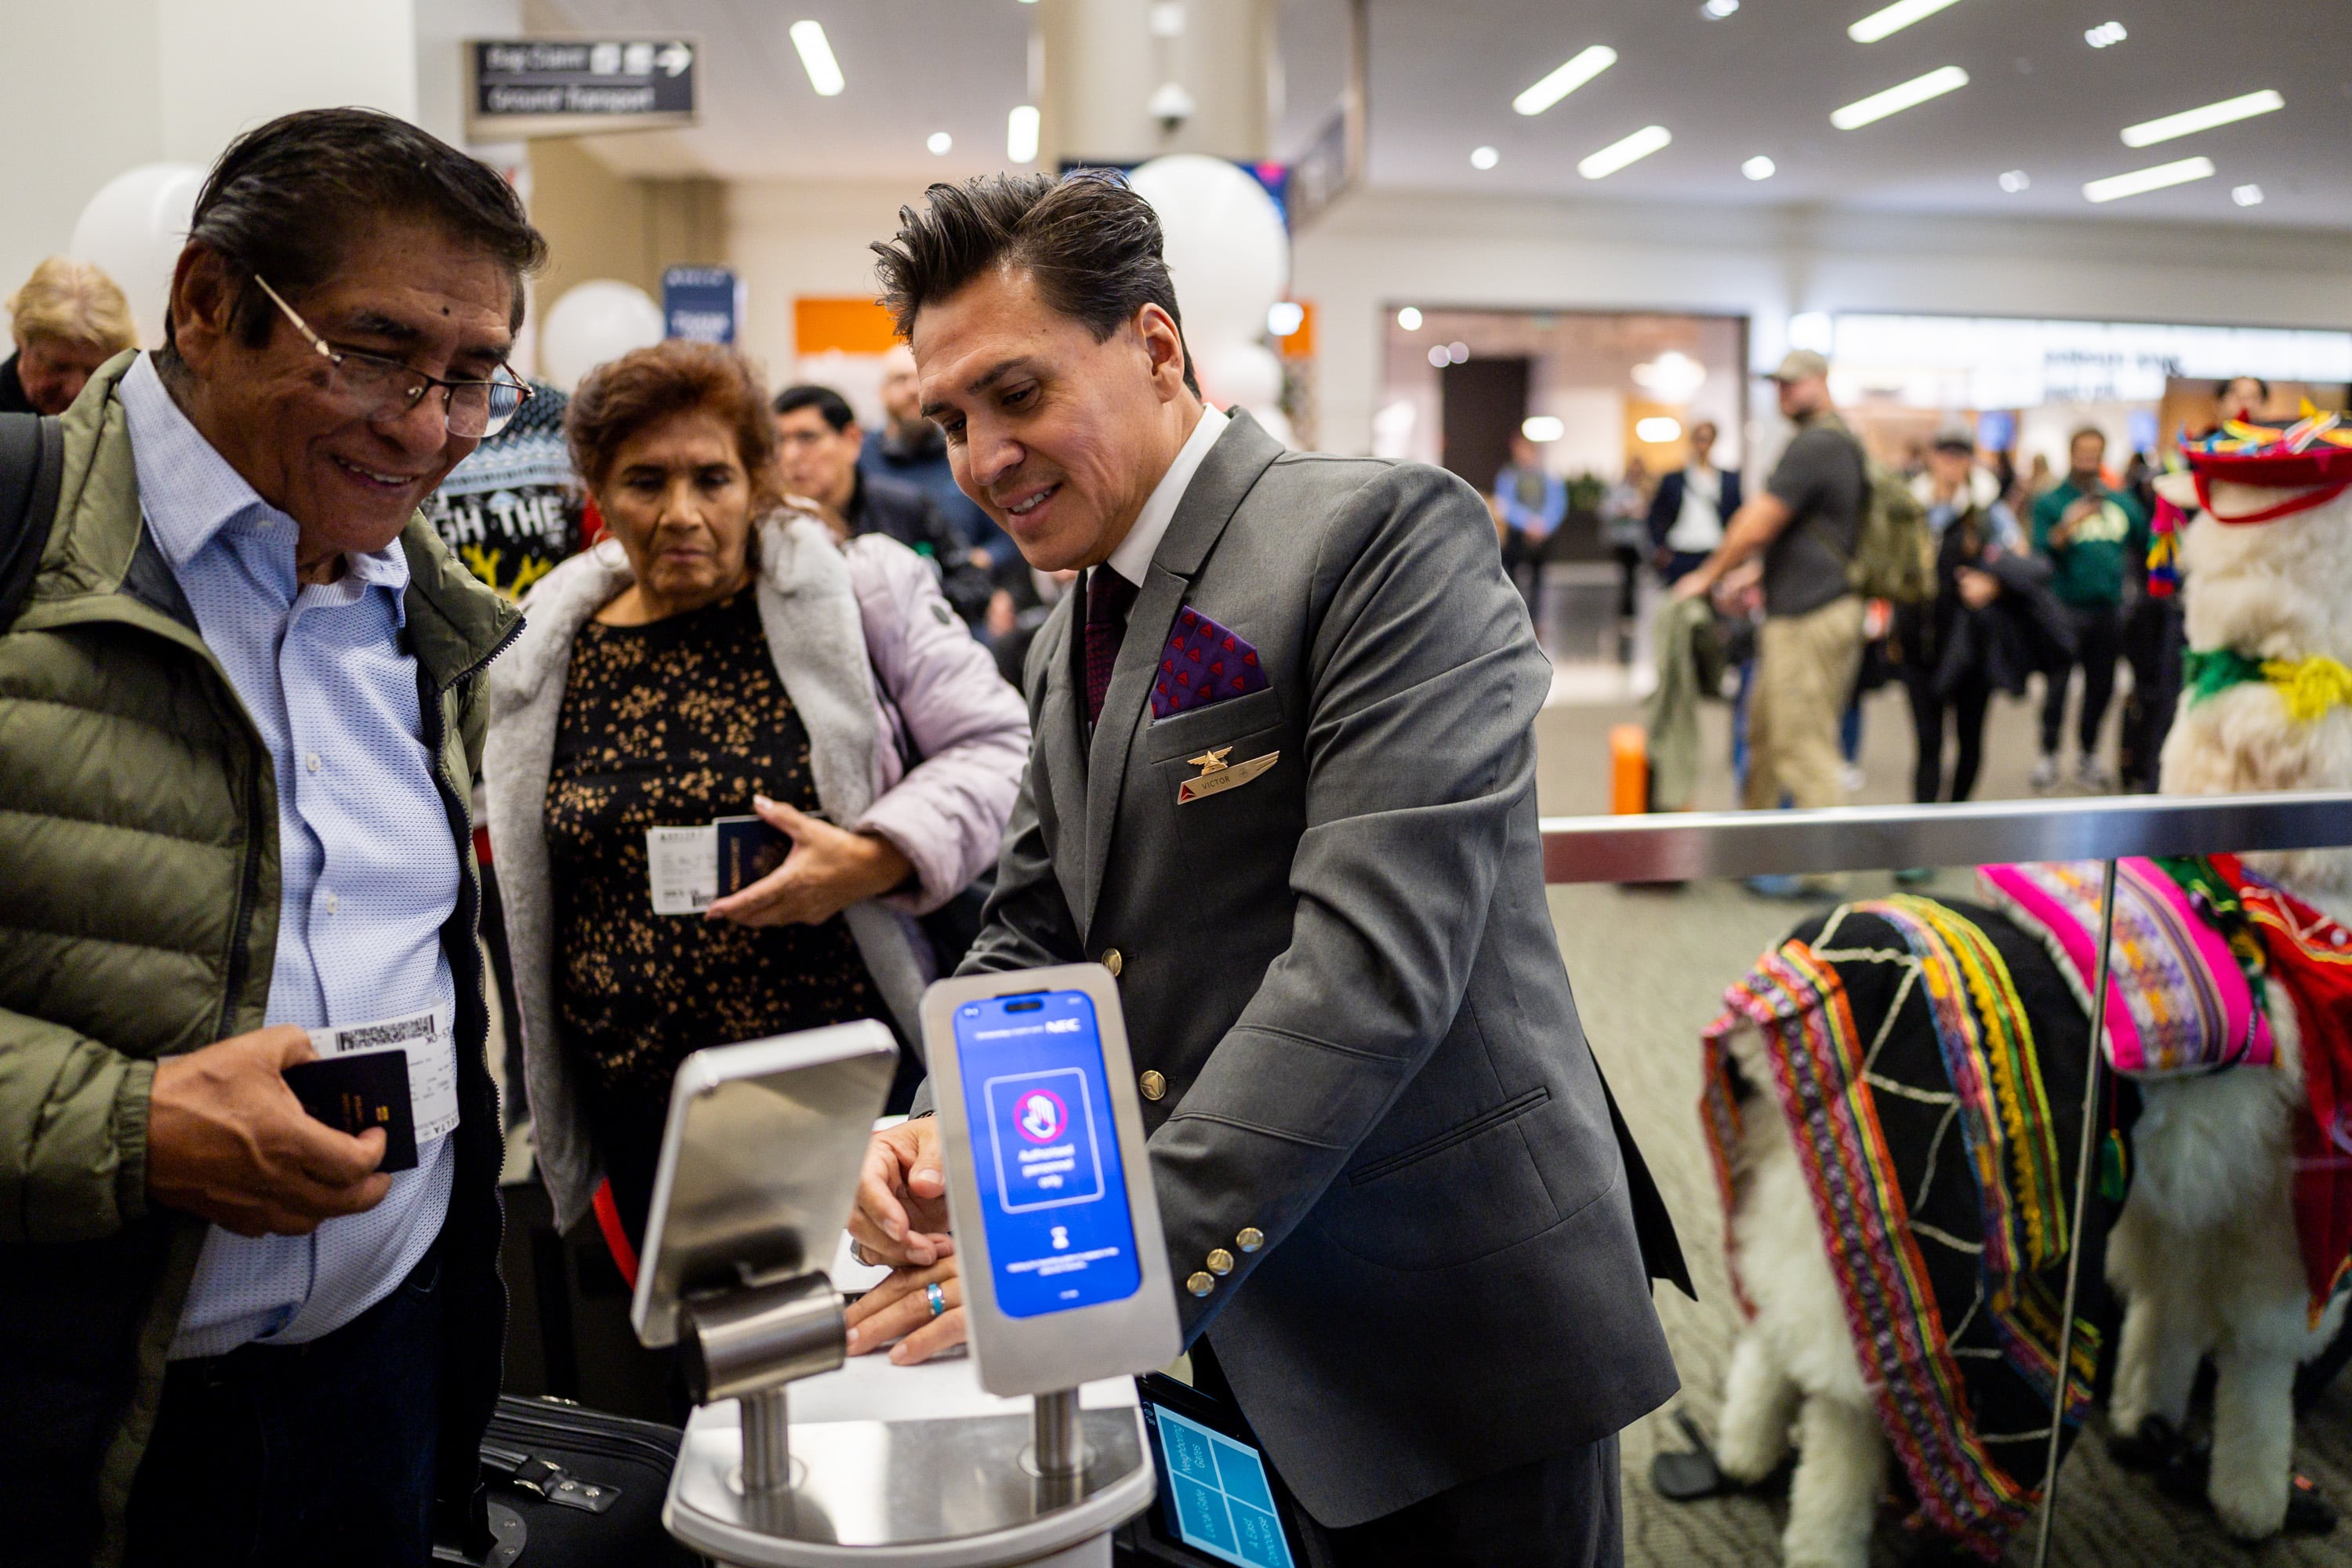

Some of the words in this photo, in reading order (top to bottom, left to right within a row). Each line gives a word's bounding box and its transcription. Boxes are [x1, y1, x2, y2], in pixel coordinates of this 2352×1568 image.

[488, 85, 563, 111] Ground
[489, 494, 567, 539] THE
[1202, 776, 1230, 789] VICTOR
[1045, 1018, 1081, 1033] NEC
[1174, 1425, 1192, 1474] Neighboring
[1193, 1443, 1205, 1468] Gates
[1196, 1489, 1210, 1512] Gate
[1202, 1513, 1215, 1538] Local
[1243, 1517, 1258, 1540] East
[1258, 1516, 1279, 1566] Concourse
